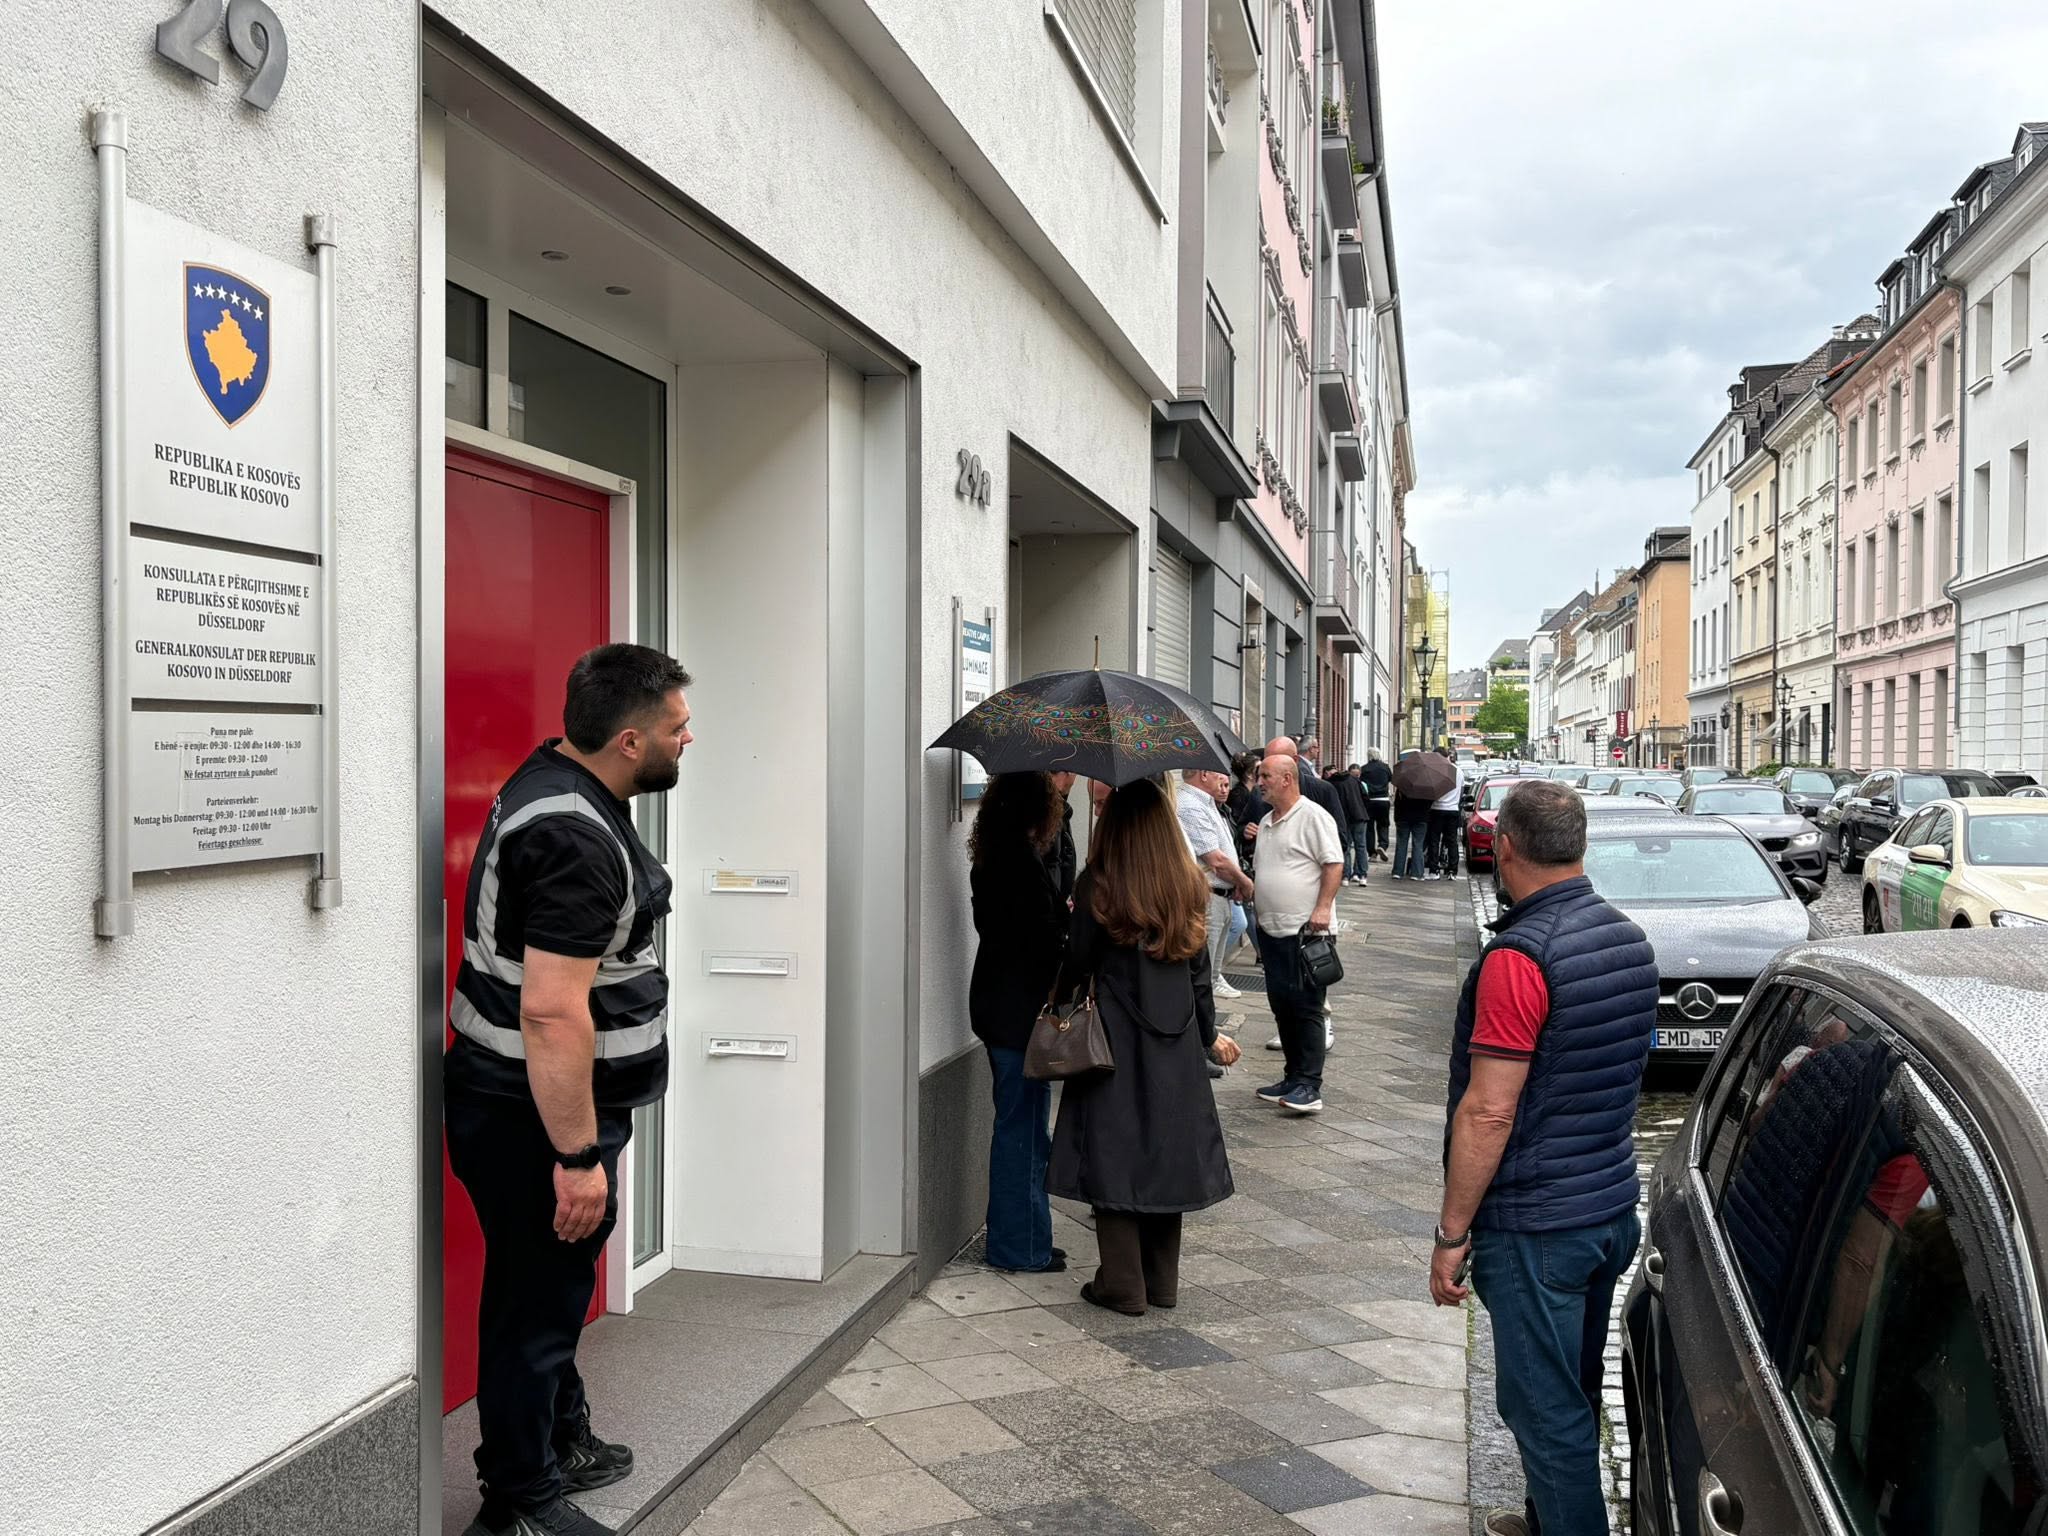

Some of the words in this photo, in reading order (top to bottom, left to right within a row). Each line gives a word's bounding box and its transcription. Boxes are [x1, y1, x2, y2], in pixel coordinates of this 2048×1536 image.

[156, 0, 288, 112] 29
[154, 443, 234, 476] REPUBLIKA
[236, 462, 244, 478] E
[247, 465, 301, 491] KOSOVËS
[957, 448, 991, 507] 29a
[169, 469, 238, 498] REPUBLIK
[240, 485, 289, 508] KOSOVO
[144, 564, 216, 587] KONSULLATA
[219, 574, 226, 587] E
[227, 573, 302, 598] PËRGJITHSHME
[303, 586, 310, 599] E
[156, 587, 226, 608] REPUBLIKËS
[227, 594, 240, 610] SË
[241, 598, 286, 616] KOSOVËS
[287, 601, 300, 617] NË
[198, 611, 266, 632] DÜSSELDORF
[135, 639, 245, 661] GENERALKONSULAT
[246, 649, 267, 663] DER
[269, 650, 317, 666] REPUBLIK
[167, 663, 213, 679] KOSOVO
[214, 666, 227, 680] IN
[228, 665, 293, 684] DÜSSELDORF
[210, 726, 227, 736] Puna
[155, 741, 160, 750] E
[210, 741, 229, 750] 09:30
[196, 755, 201, 765] E
[228, 754, 246, 764] 09:30
[133, 815, 161, 826] Montag
[162, 814, 173, 824] bis
[1656, 1031, 1690, 1046] EMD
